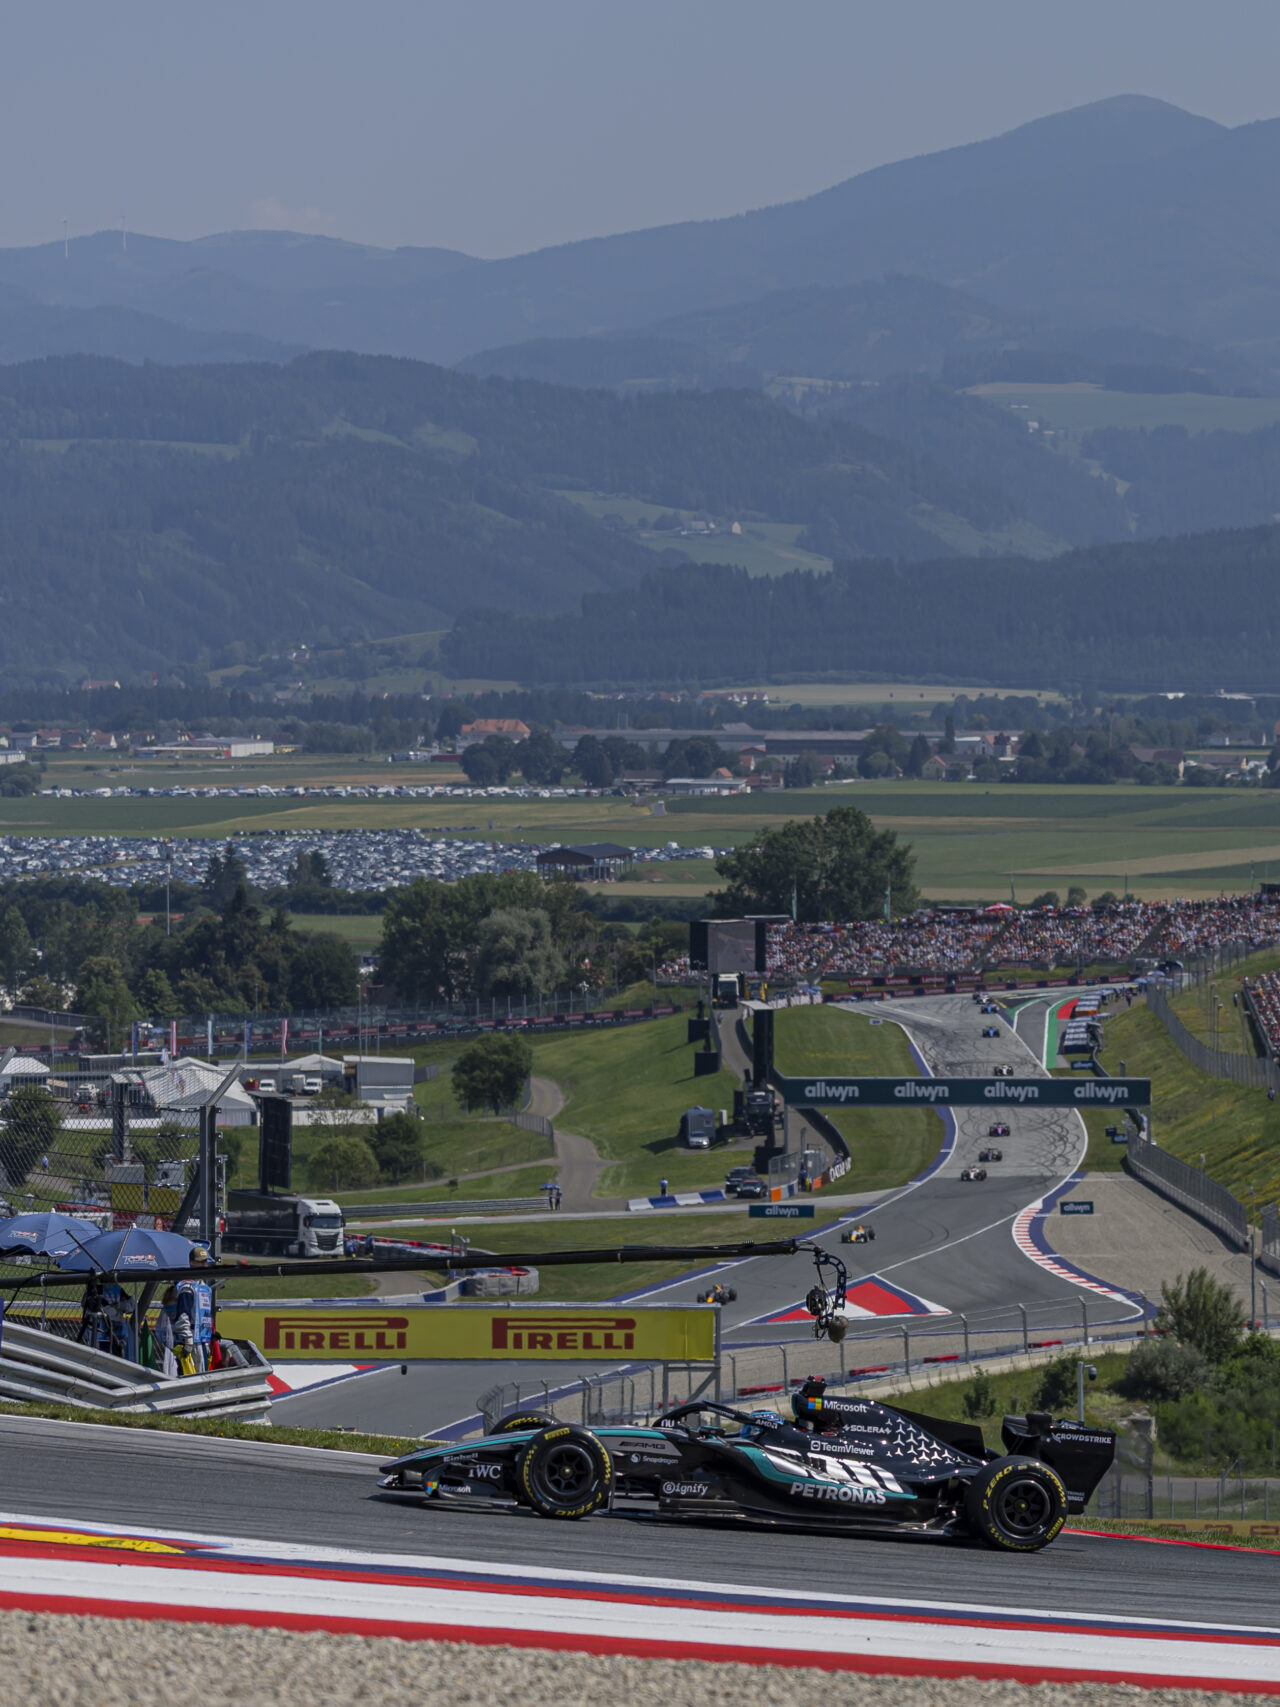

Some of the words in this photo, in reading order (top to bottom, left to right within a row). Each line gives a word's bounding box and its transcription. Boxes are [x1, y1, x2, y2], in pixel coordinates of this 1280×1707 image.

[804, 1081, 860, 1102] allwyn
[894, 1081, 949, 1102] allwyn
[983, 1081, 1039, 1102] allwyn
[1073, 1082, 1129, 1102] allwyn
[765, 1206, 799, 1218] allwyn
[1063, 1203, 1091, 1213] allwyn
[264, 1317, 409, 1349] PIRELLI
[492, 1318, 636, 1350] PIRELLI
[823, 1400, 868, 1413] Microsoft
[661, 1419, 675, 1427] nu
[850, 1425, 885, 1434] SOLERA
[1054, 1433, 1112, 1444] CROWDSTRIKE
[634, 1442, 666, 1450] AMG
[821, 1442, 875, 1456] TeamViewer
[643, 1455, 679, 1465] Snapdragon
[468, 1464, 501, 1479] IWC
[439, 1484, 471, 1494] Microsoft
[790, 1481, 887, 1505] PETRONAS
